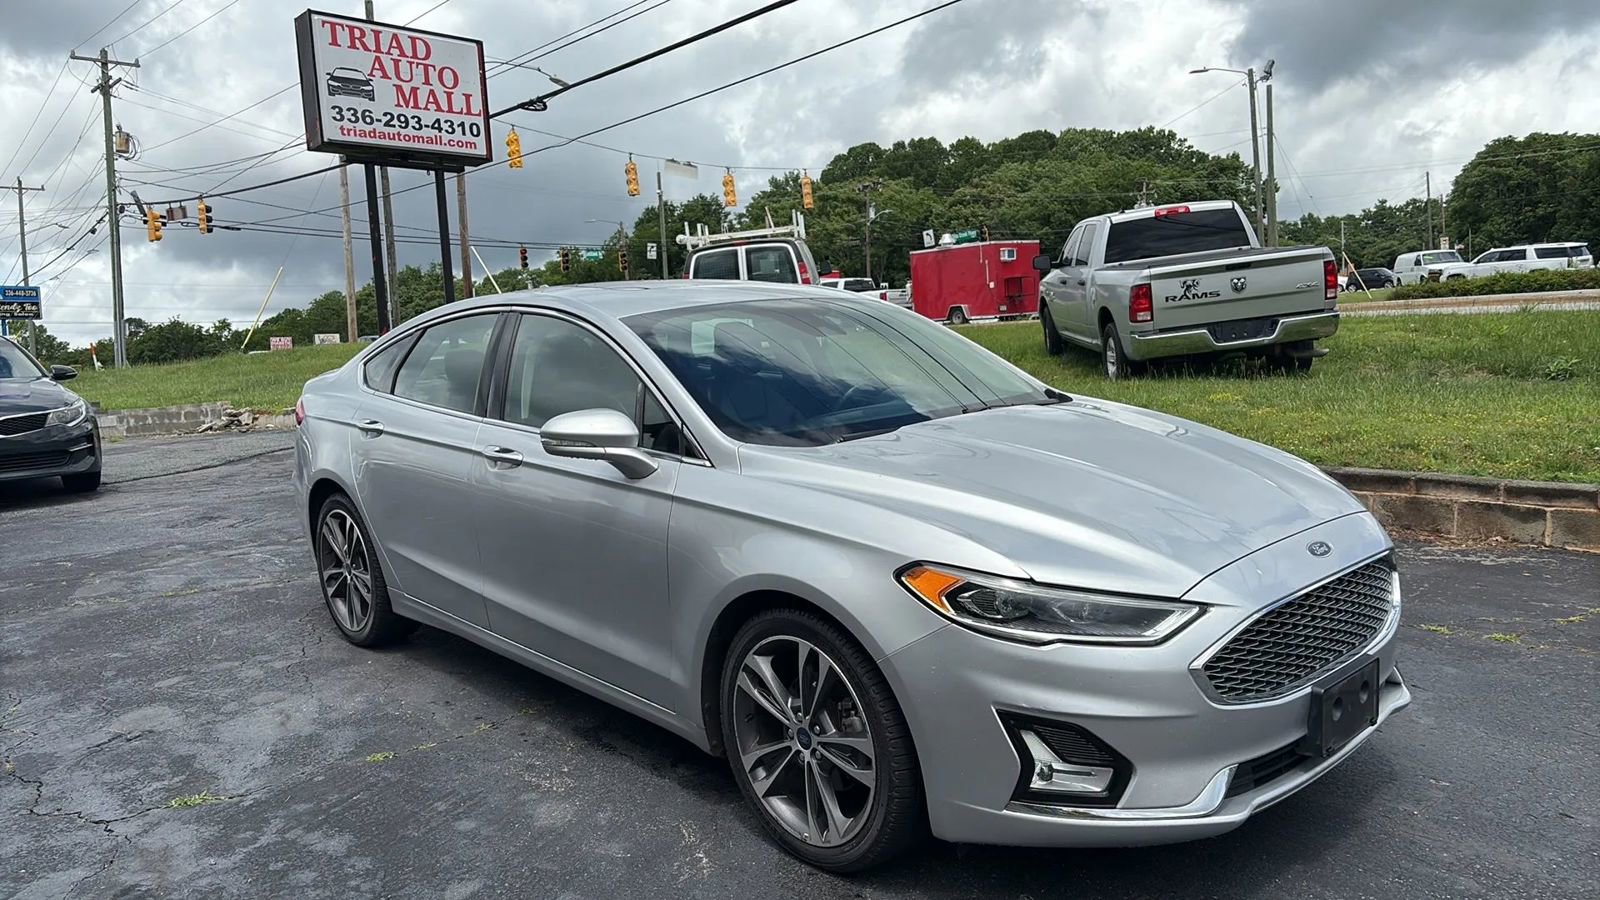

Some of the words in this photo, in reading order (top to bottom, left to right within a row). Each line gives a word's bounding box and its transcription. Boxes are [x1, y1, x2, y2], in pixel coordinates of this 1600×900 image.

[321, 20, 432, 61] TRIAD
[367, 55, 460, 90] AUTO
[392, 84, 482, 117] MALL
[330, 105, 481, 138] 336-293-4310
[339, 125, 477, 150] triadautomall.com
[1165, 290, 1221, 302] RAMS
